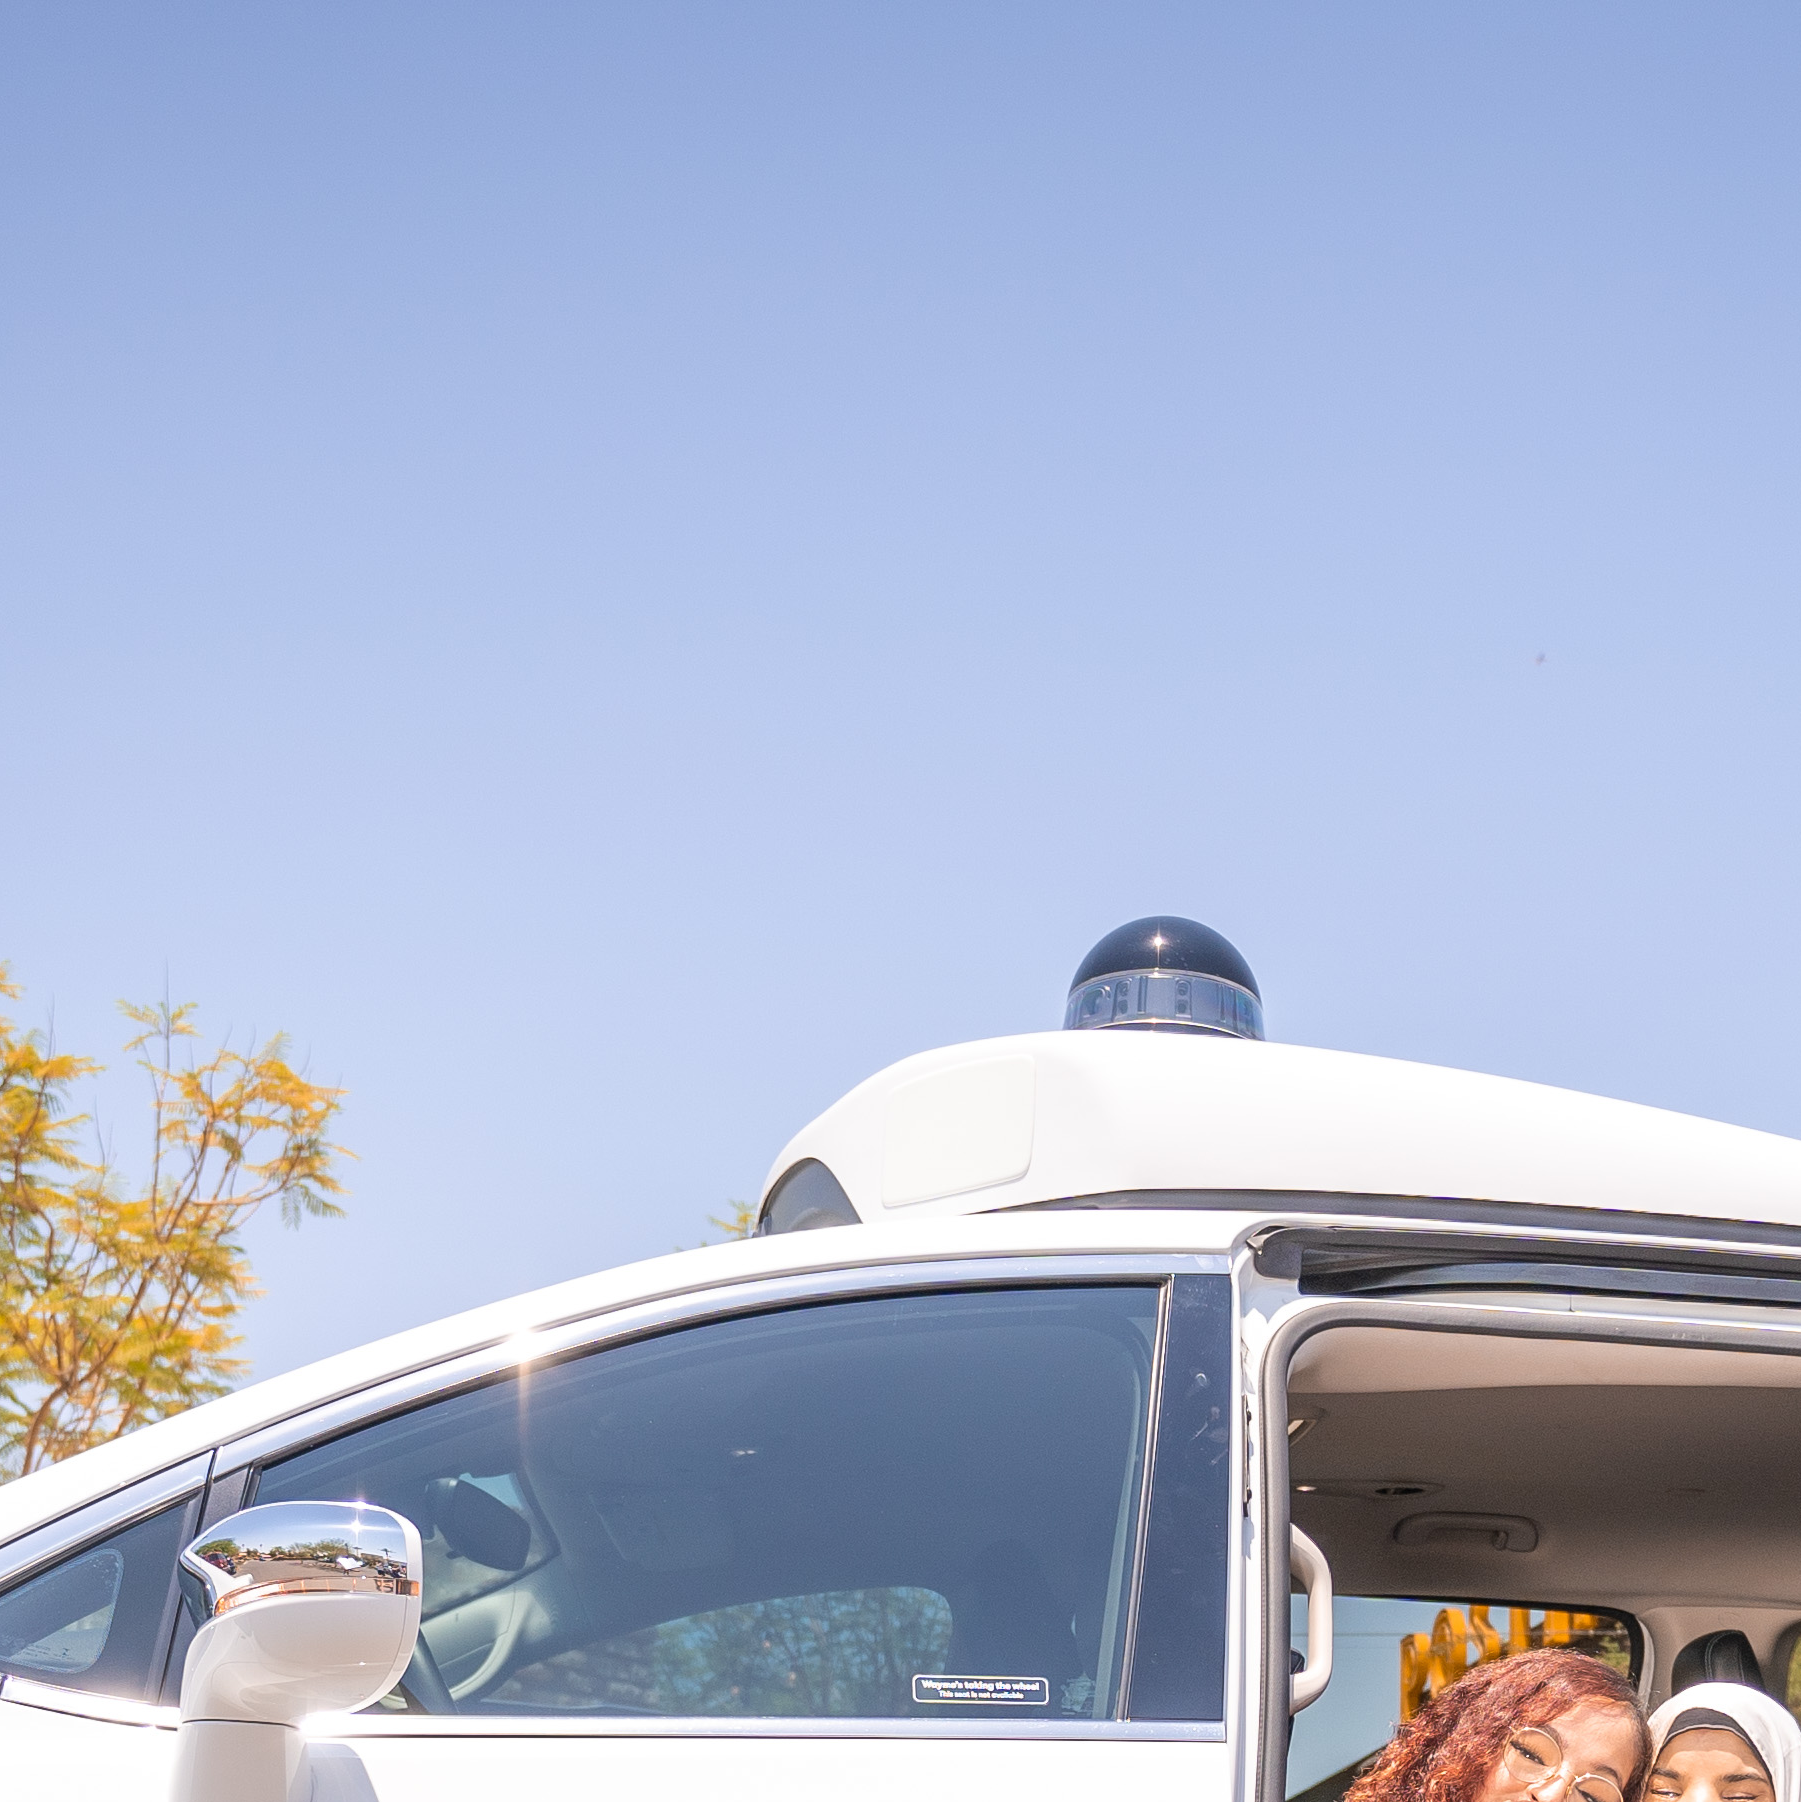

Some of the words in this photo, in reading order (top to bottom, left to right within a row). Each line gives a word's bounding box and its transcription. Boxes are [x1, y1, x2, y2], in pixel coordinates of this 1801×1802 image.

[921, 1679, 964, 1691] Waymo's
[965, 1681, 994, 1692] taking
[995, 1682, 1011, 1691] the
[1012, 1682, 1040, 1691] wheel
[938, 1690, 953, 1698] This
[991, 1691, 1024, 1699] available
